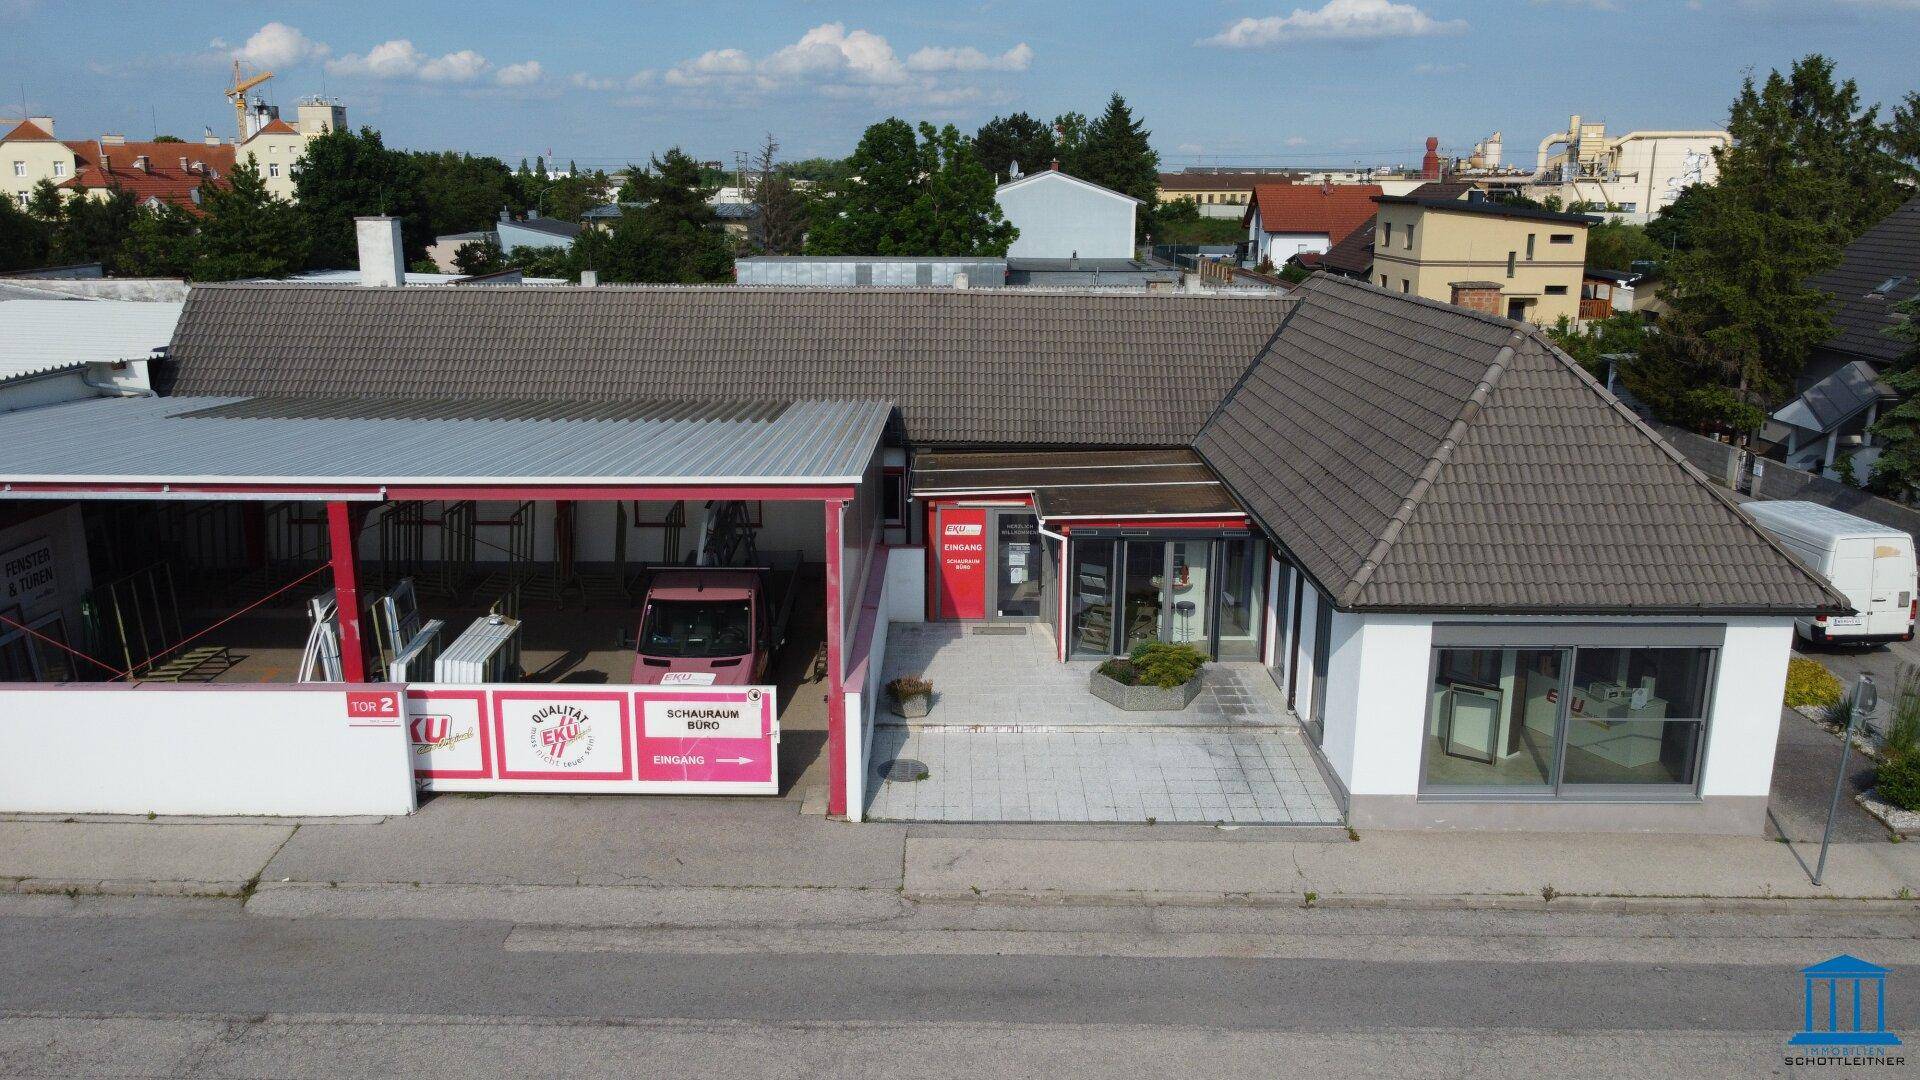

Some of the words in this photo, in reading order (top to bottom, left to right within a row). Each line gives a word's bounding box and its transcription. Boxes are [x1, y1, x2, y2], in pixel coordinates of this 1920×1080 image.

[946, 525, 966, 534] EKU
[5, 547, 51, 577] FENSTER
[8, 582, 18, 597] &
[19, 566, 53, 592] TÜREN
[664, 673, 693, 681] EKU
[351, 701, 377, 712] TOR
[381, 697, 394, 712] 2
[1546, 687, 1585, 713] EU
[531, 704, 589, 724] QUALITÄT
[667, 709, 740, 719] SCHAURAUM
[687, 720, 720, 730] BÜRO
[542, 723, 579, 745] EKU
[530, 727, 538, 748] muss
[536, 749, 560, 767] nicht
[563, 755, 585, 768] teuer
[653, 755, 705, 765] EINGANG
